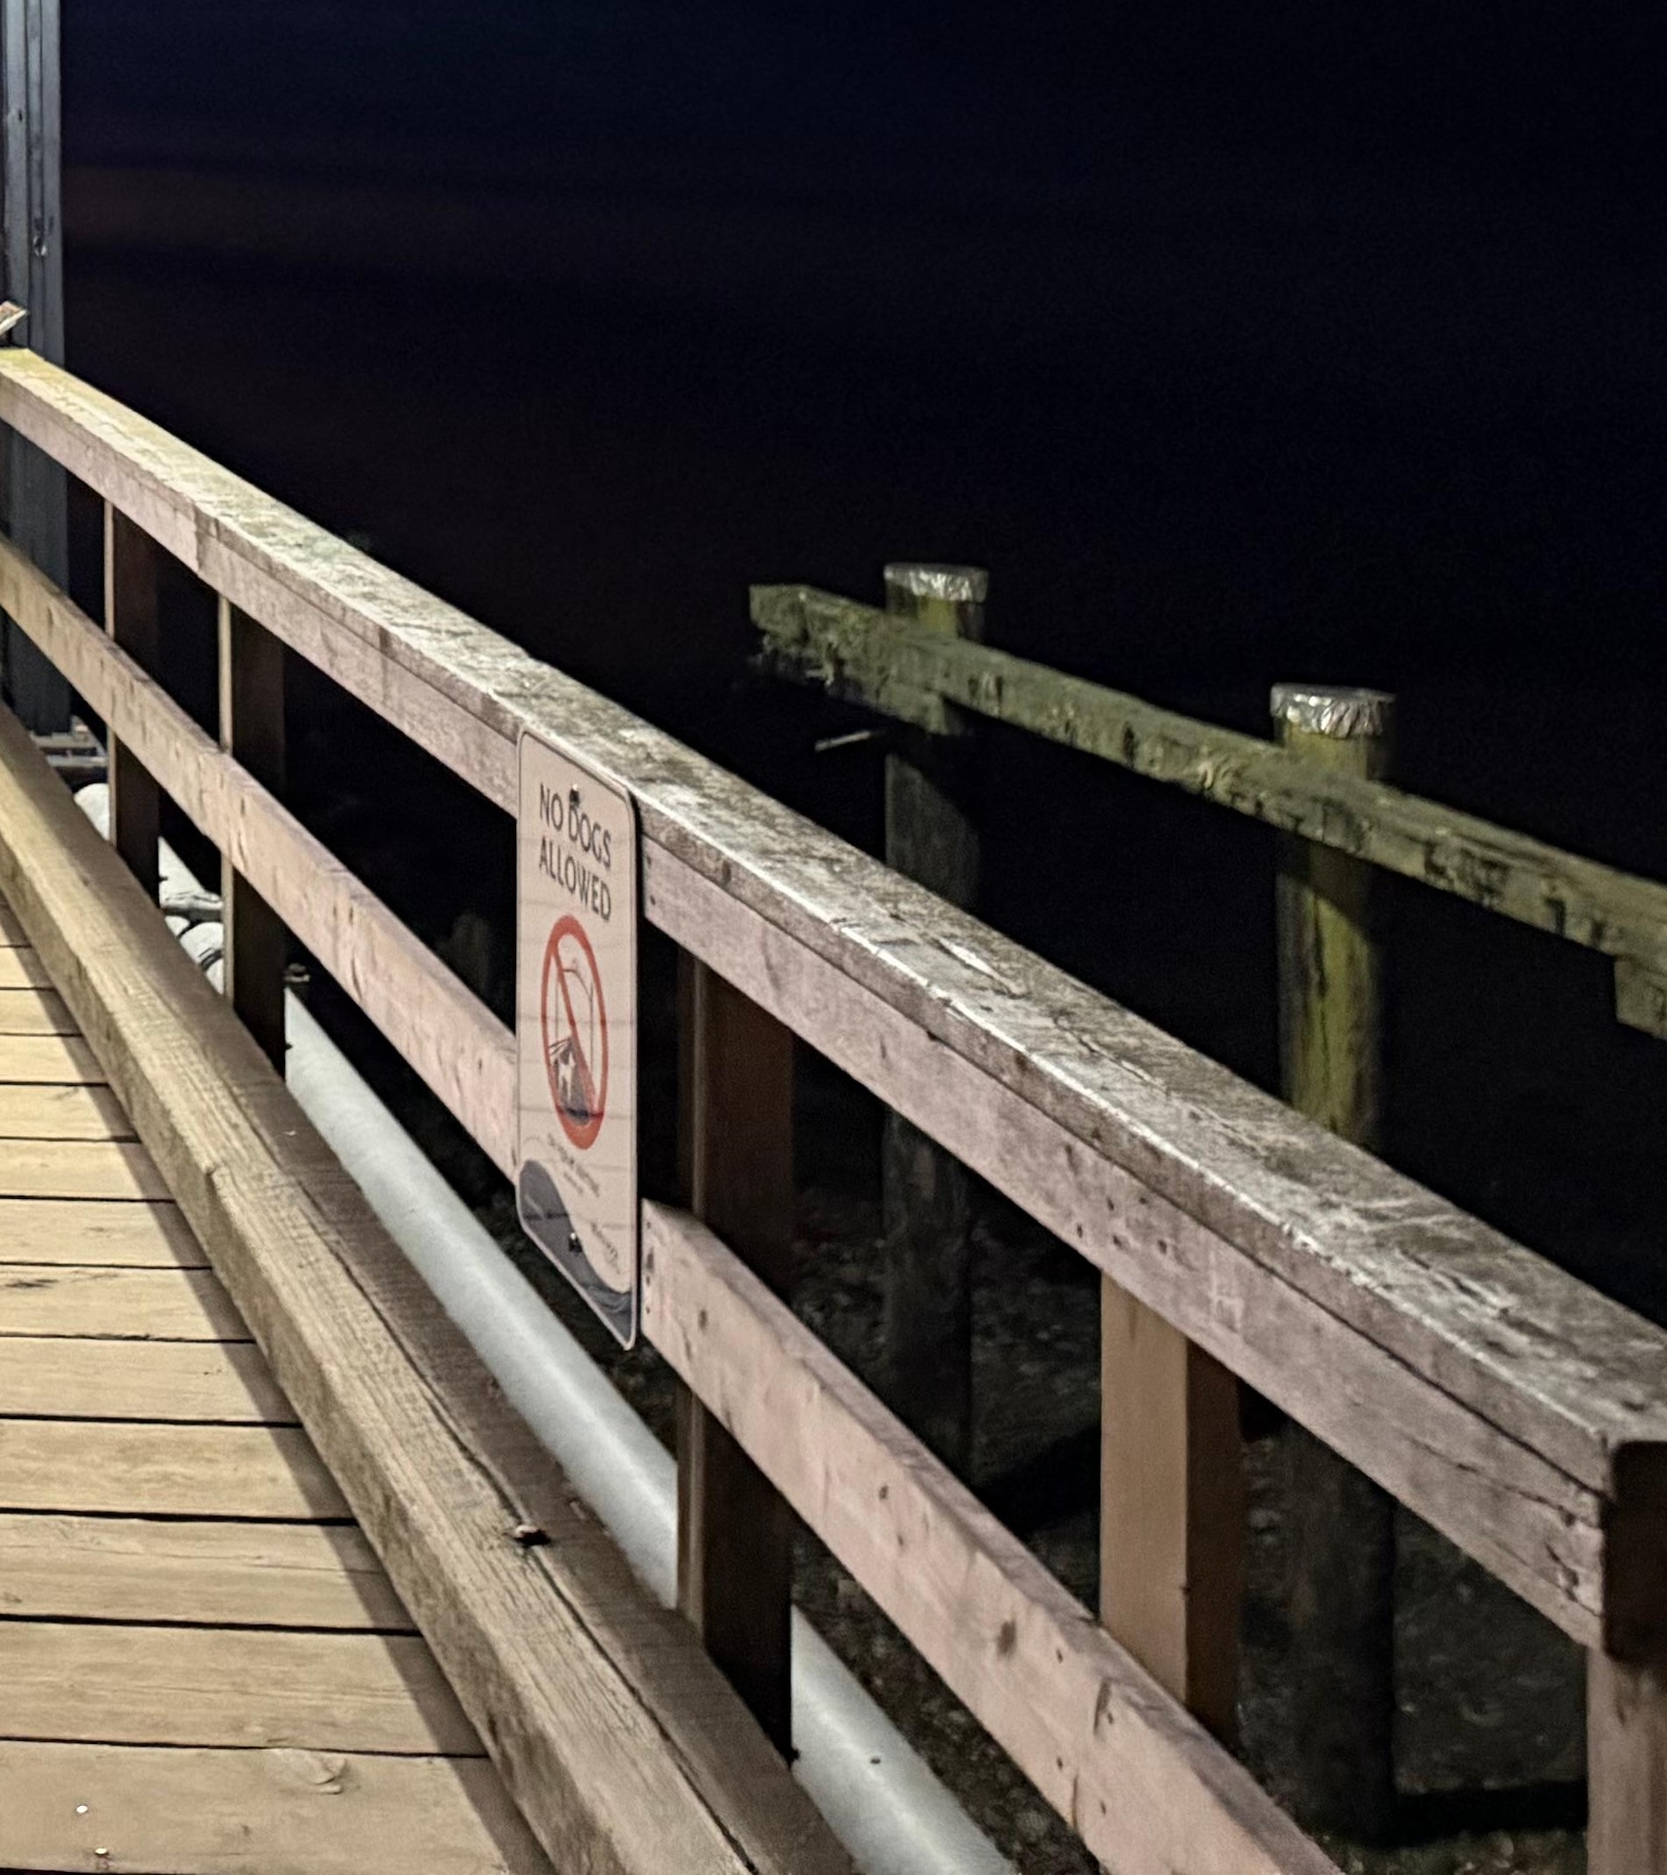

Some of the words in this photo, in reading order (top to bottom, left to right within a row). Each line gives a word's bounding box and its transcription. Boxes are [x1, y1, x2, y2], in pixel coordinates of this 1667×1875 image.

[539, 781, 564, 832] NO
[568, 804, 612, 872] DOGS
[539, 834, 612, 922] ALLOWED
